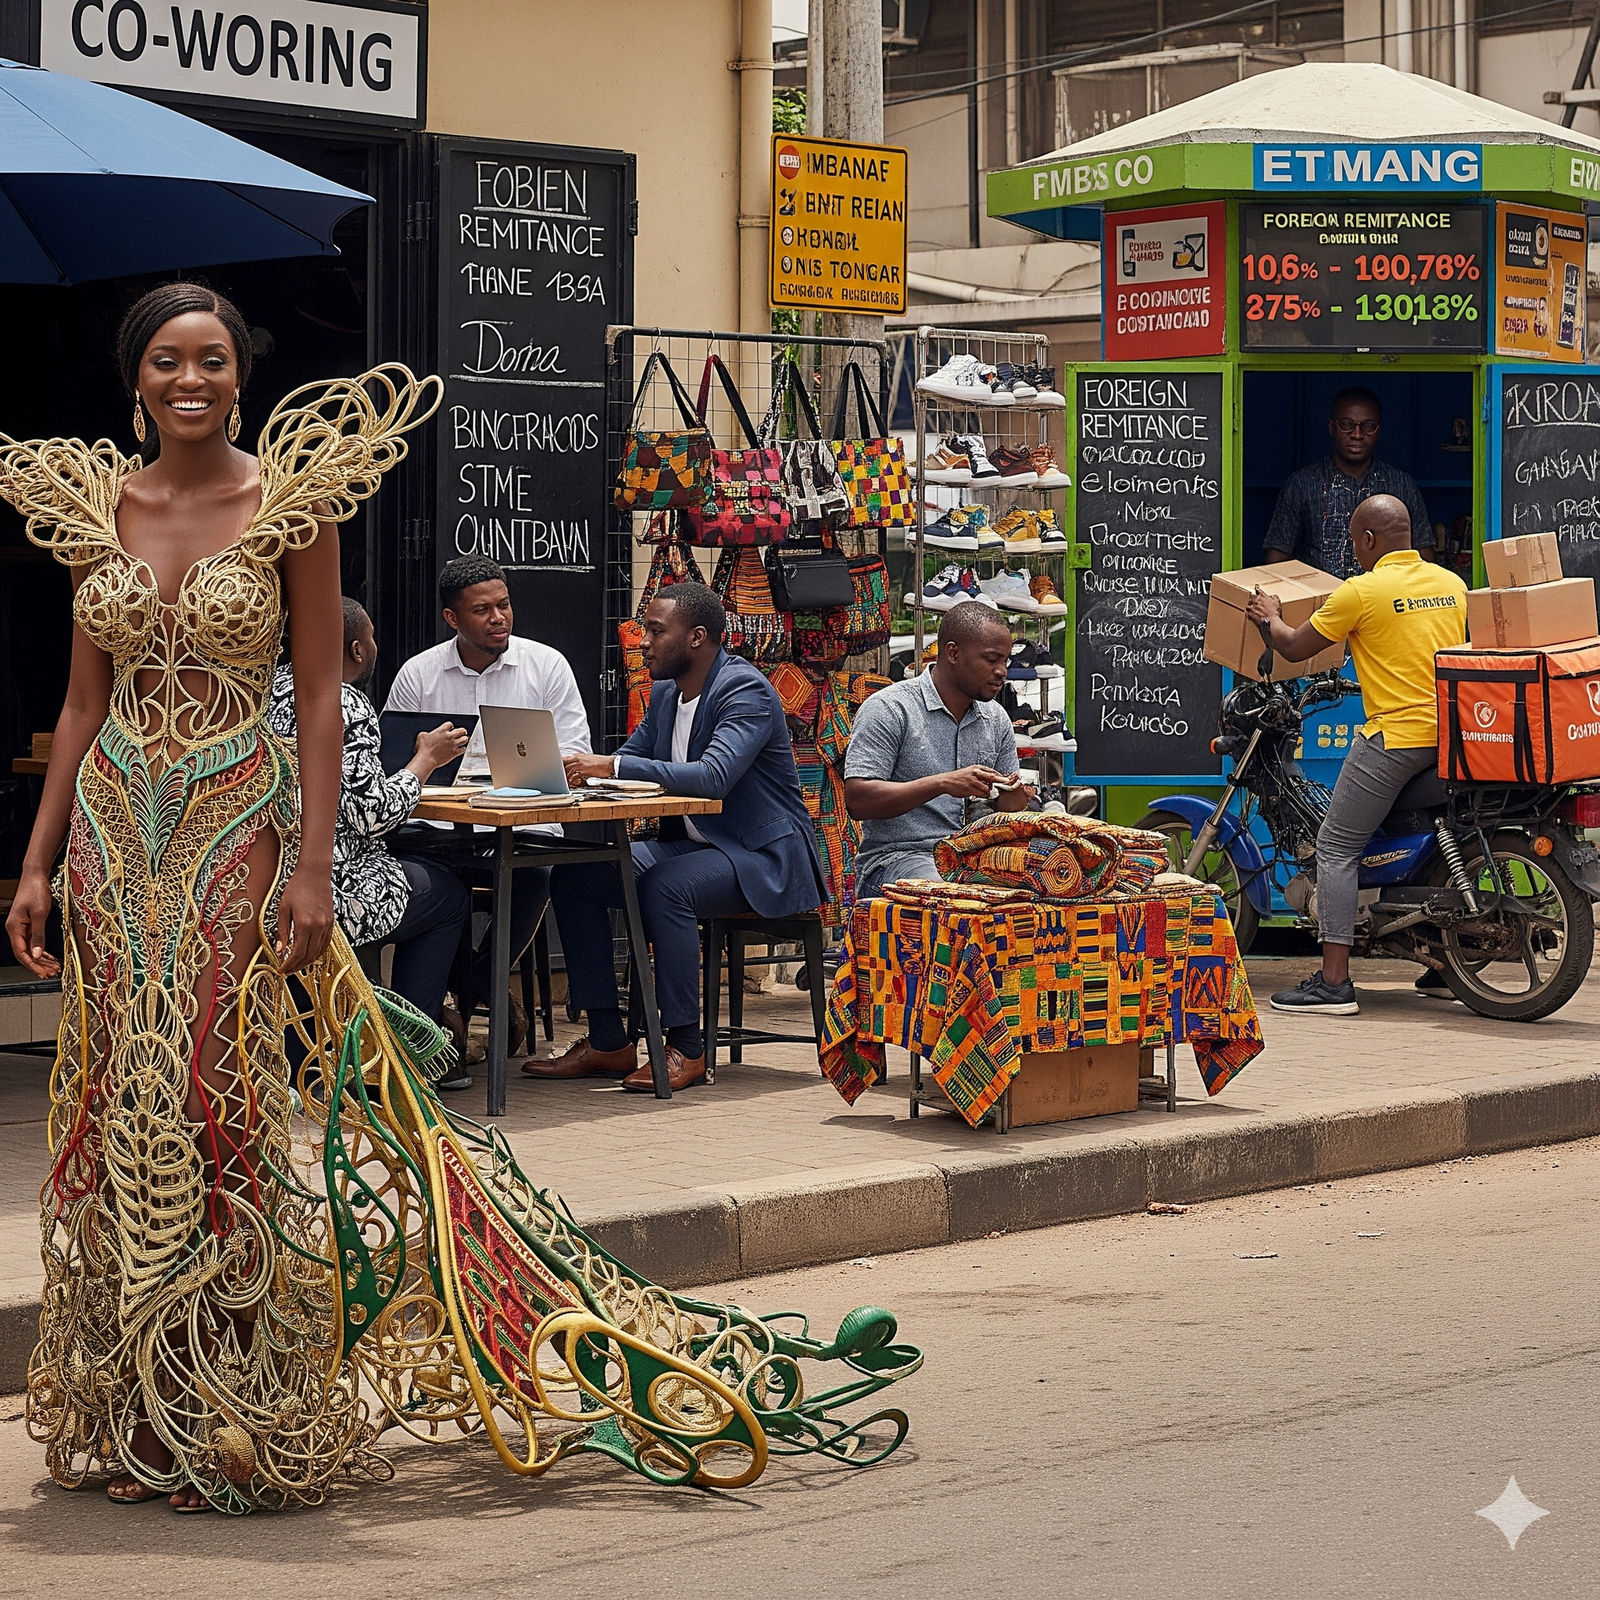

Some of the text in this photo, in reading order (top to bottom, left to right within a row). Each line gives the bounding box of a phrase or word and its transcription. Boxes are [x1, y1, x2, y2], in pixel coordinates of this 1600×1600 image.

[71, 0, 393, 92] CO-WORING
[1114, 154, 1154, 188] CO
[1332, 149, 1480, 183] MANG
[475, 161, 587, 214] FOBIEN
[459, 213, 605, 258] REMITANCE
[1344, 212, 1451, 228] REMITANCE
[1084, 379, 1188, 408] FOREIGN
[1081, 413, 1209, 441] REMITANCE
[458, 462, 533, 512] STME
